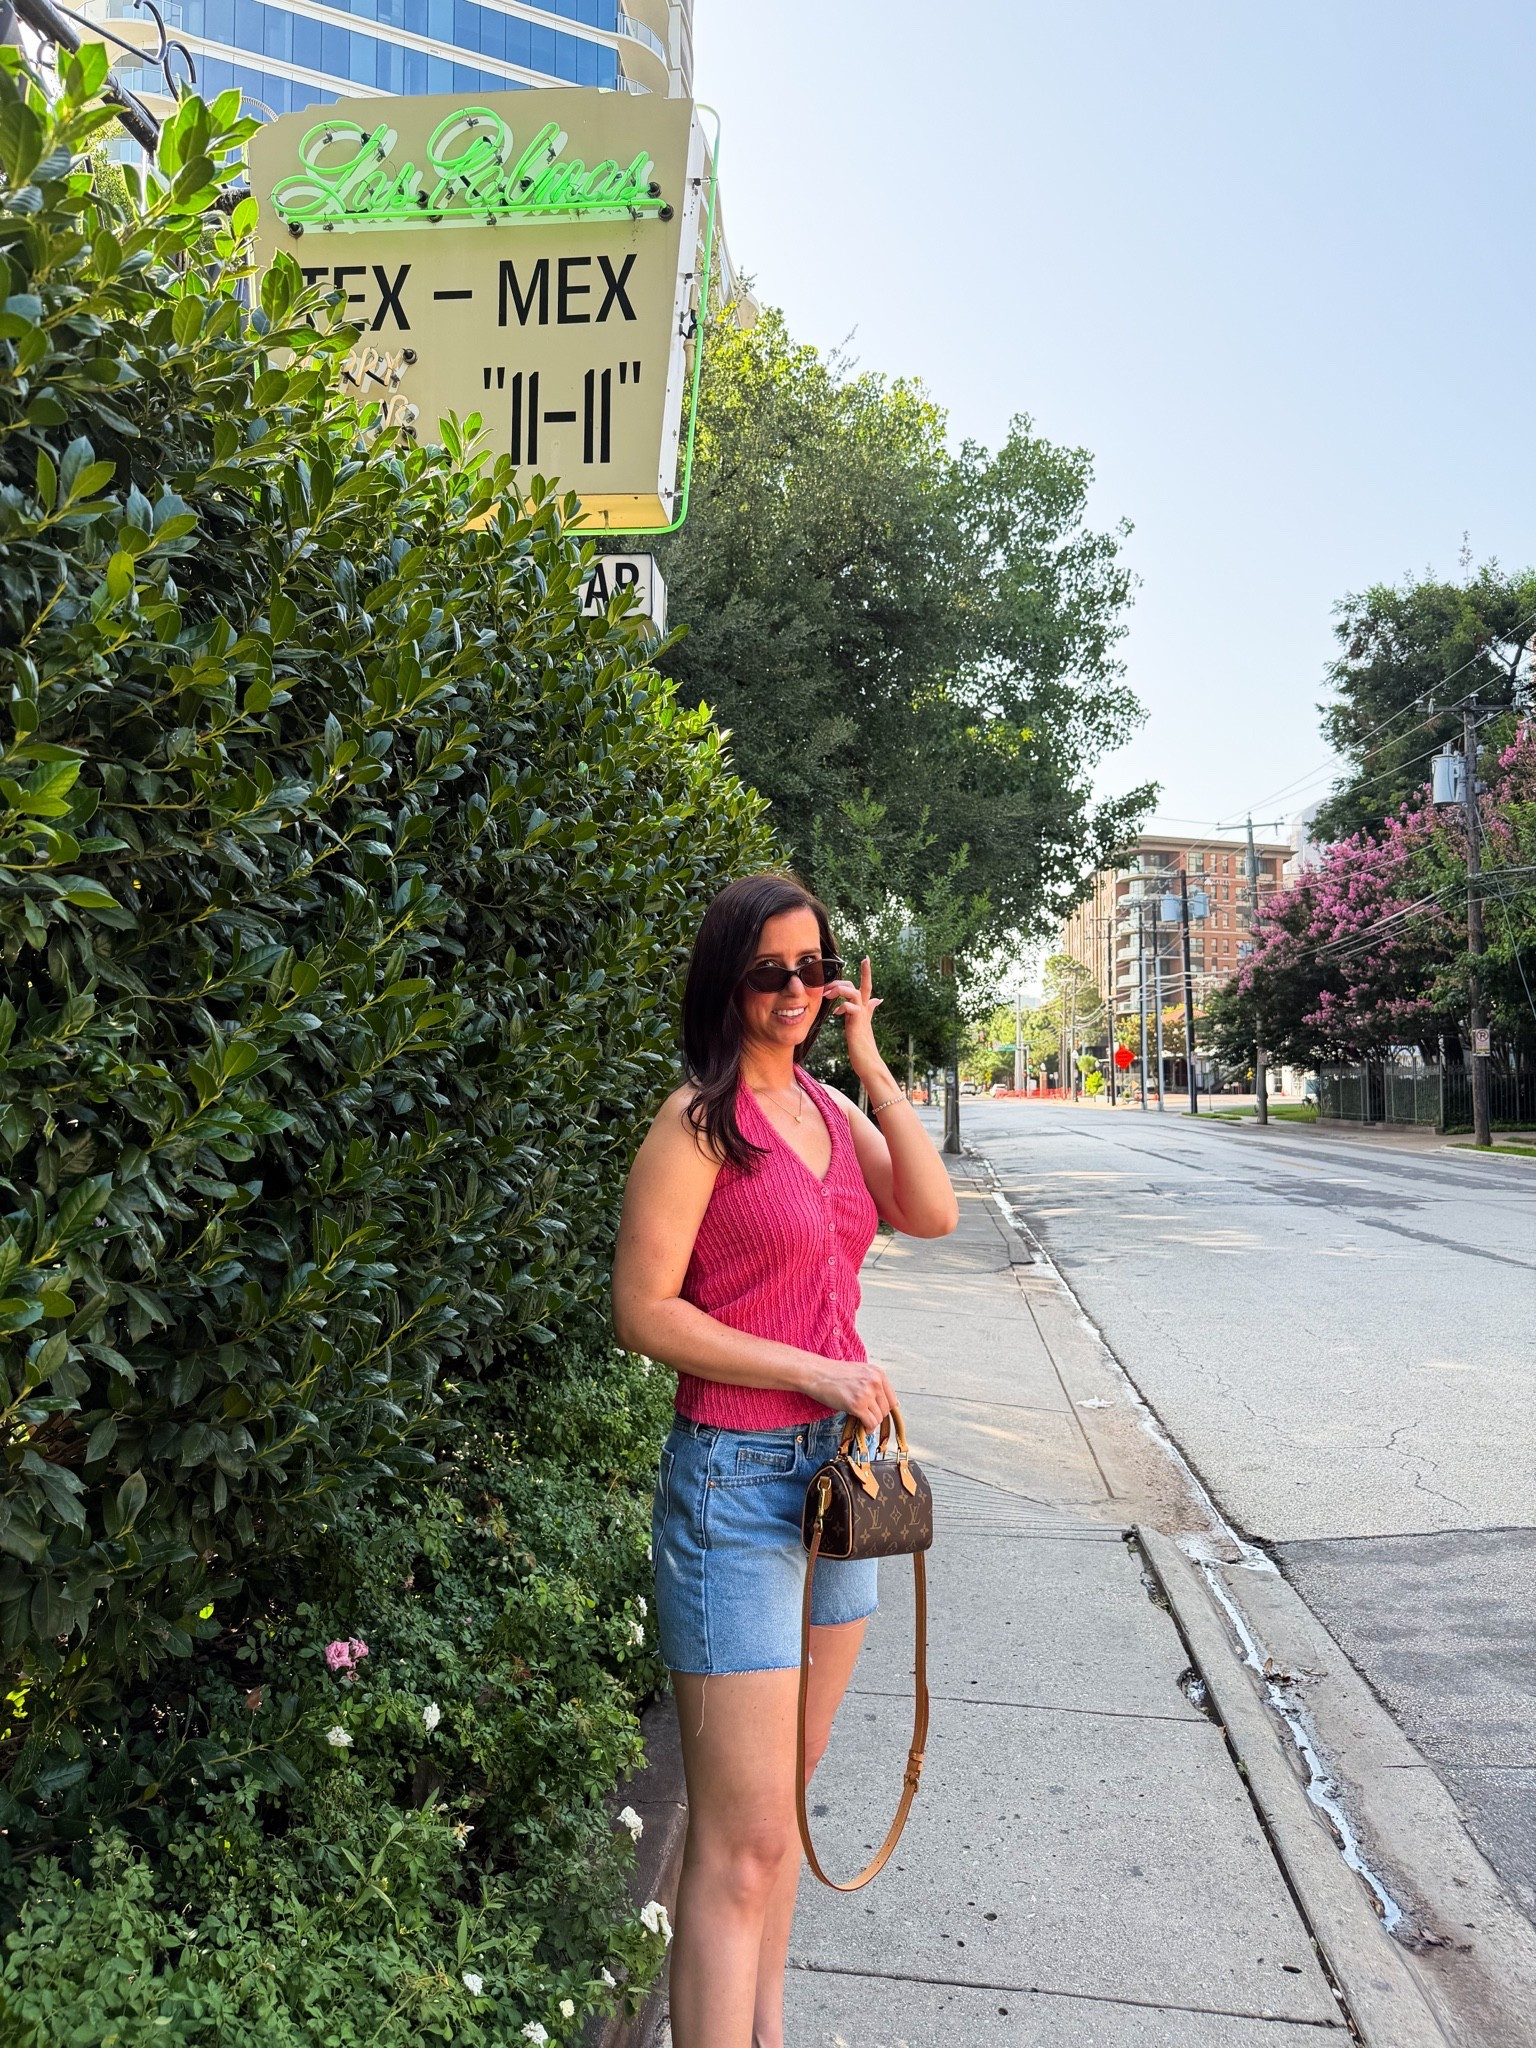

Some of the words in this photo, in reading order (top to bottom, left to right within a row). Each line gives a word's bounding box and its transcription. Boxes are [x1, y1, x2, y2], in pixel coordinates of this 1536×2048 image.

[271, 119, 418, 214] Las
[425, 106, 650, 210] Palmas
[299, 263, 412, 332] TEX
[498, 253, 638, 327] MEX
